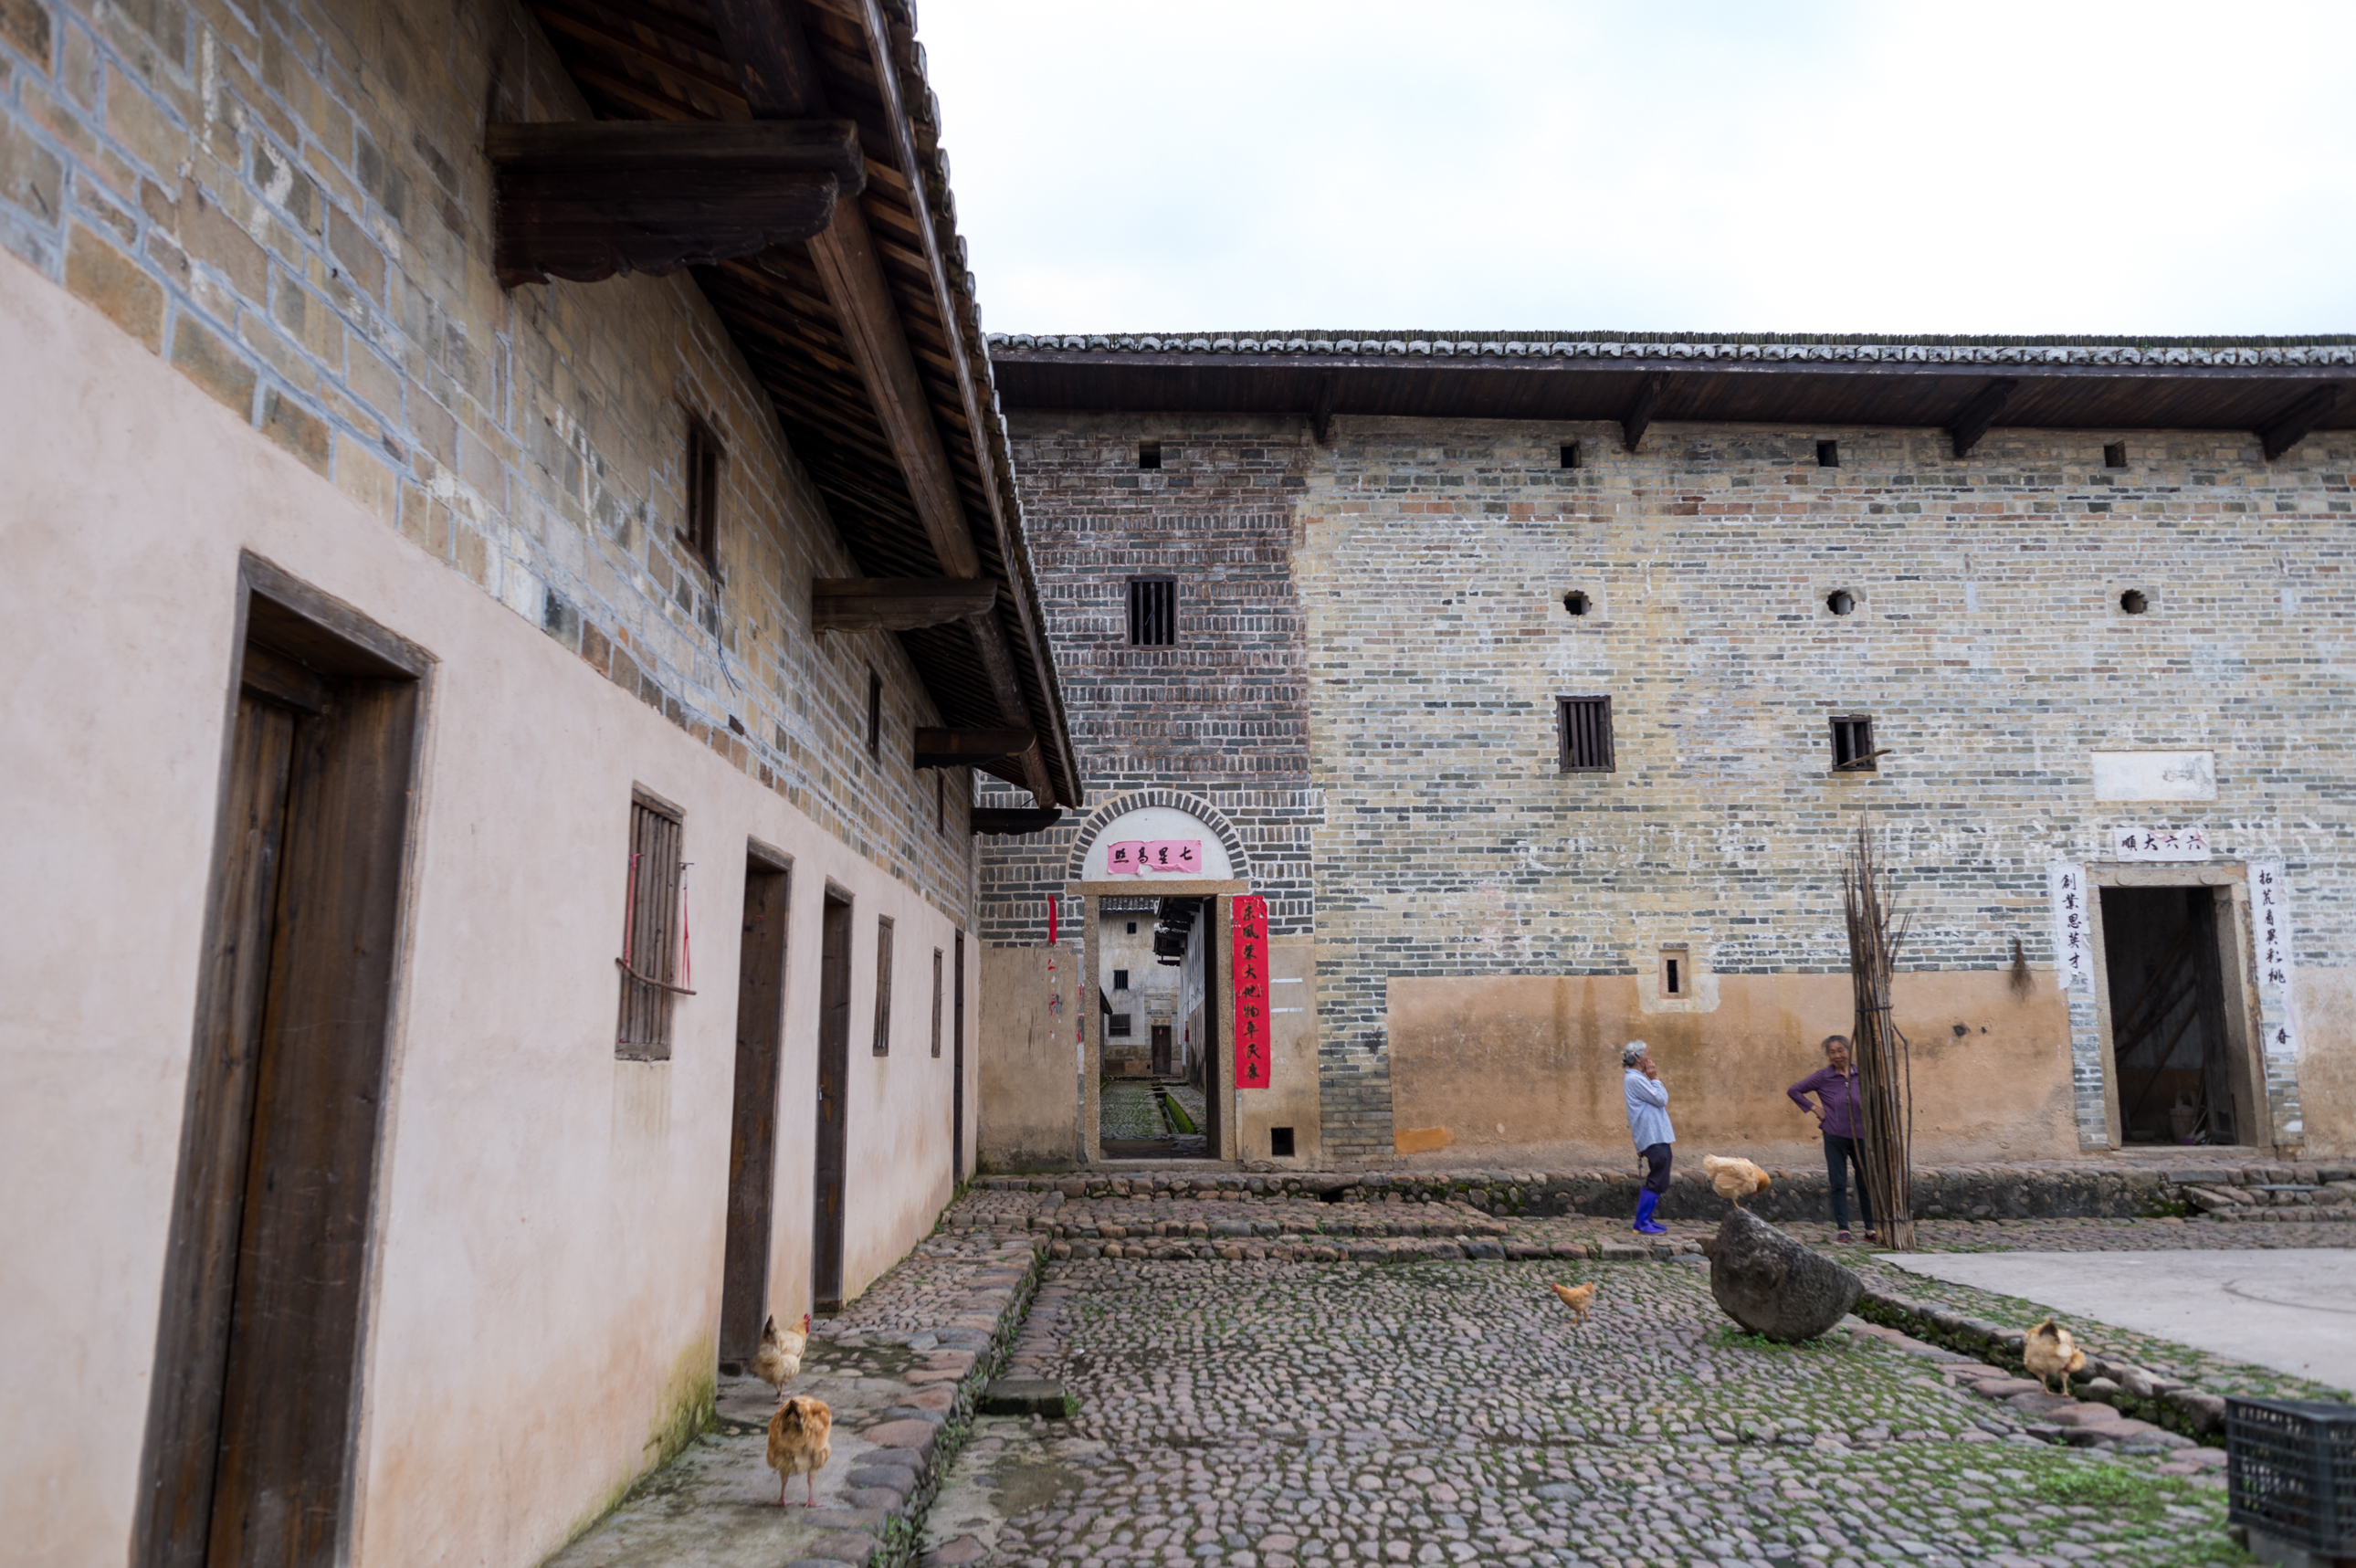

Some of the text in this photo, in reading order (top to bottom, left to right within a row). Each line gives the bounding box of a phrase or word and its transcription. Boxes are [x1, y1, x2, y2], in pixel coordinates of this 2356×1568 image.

[2121, 833, 2201, 851] 六六大順
[2060, 872, 2083, 975] 創業思英才
